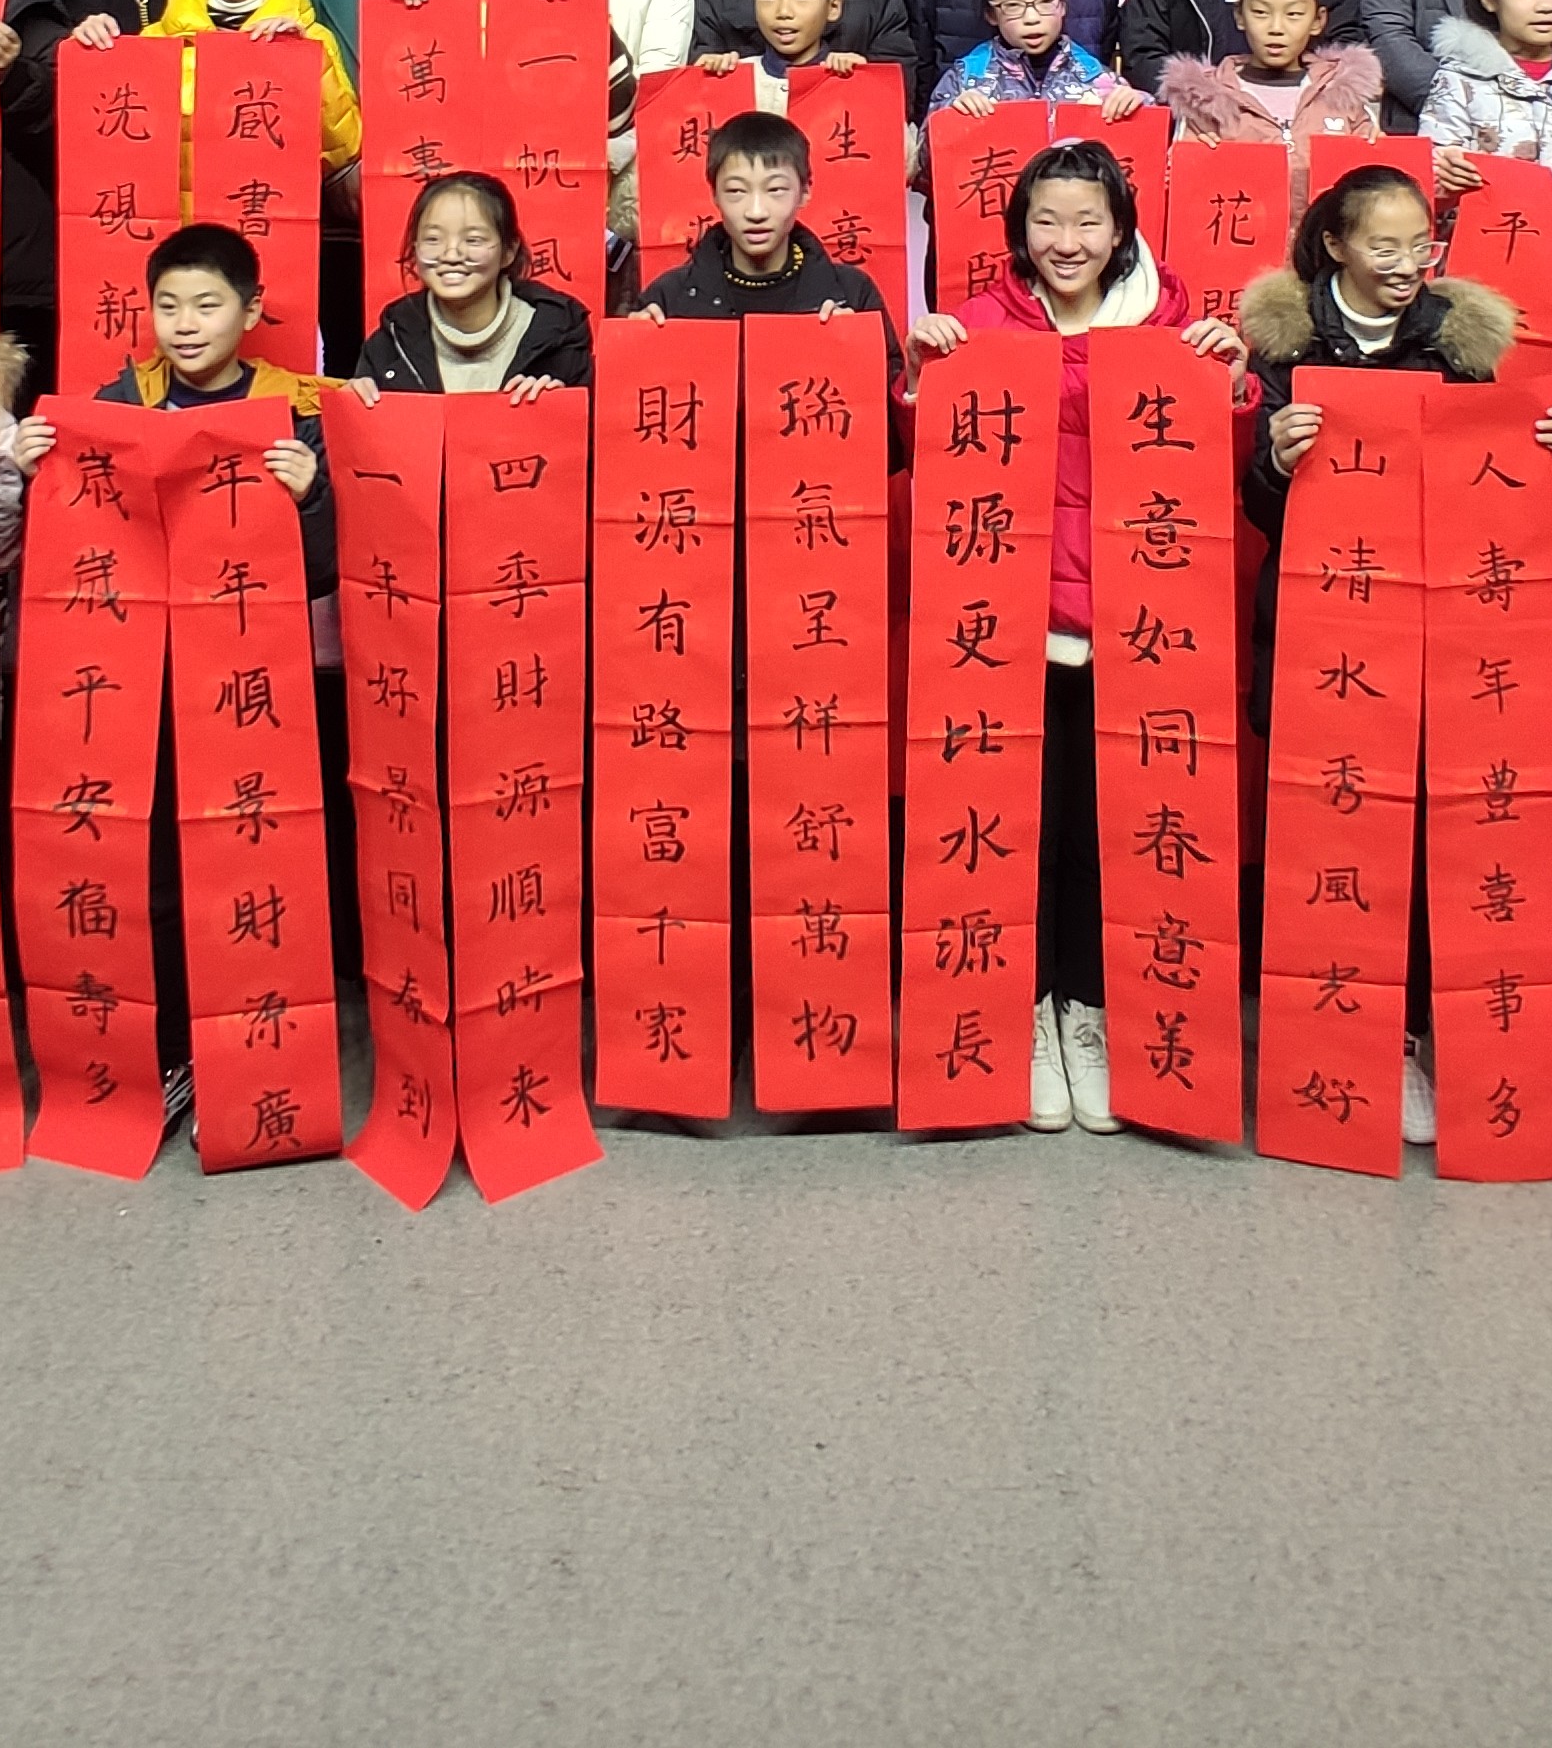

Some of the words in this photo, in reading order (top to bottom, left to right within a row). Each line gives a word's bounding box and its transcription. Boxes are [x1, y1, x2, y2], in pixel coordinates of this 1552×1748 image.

[821, 108, 873, 267] 生意
[630, 382, 704, 1063] 財源有路富千家
[778, 377, 859, 1063] 瑞氣呈祥舒萬物
[934, 389, 1025, 1081] 財源更比水源長
[1119, 383, 1215, 1091] 生意如同春意美
[1290, 438, 1387, 1126] 山清水秀風光好
